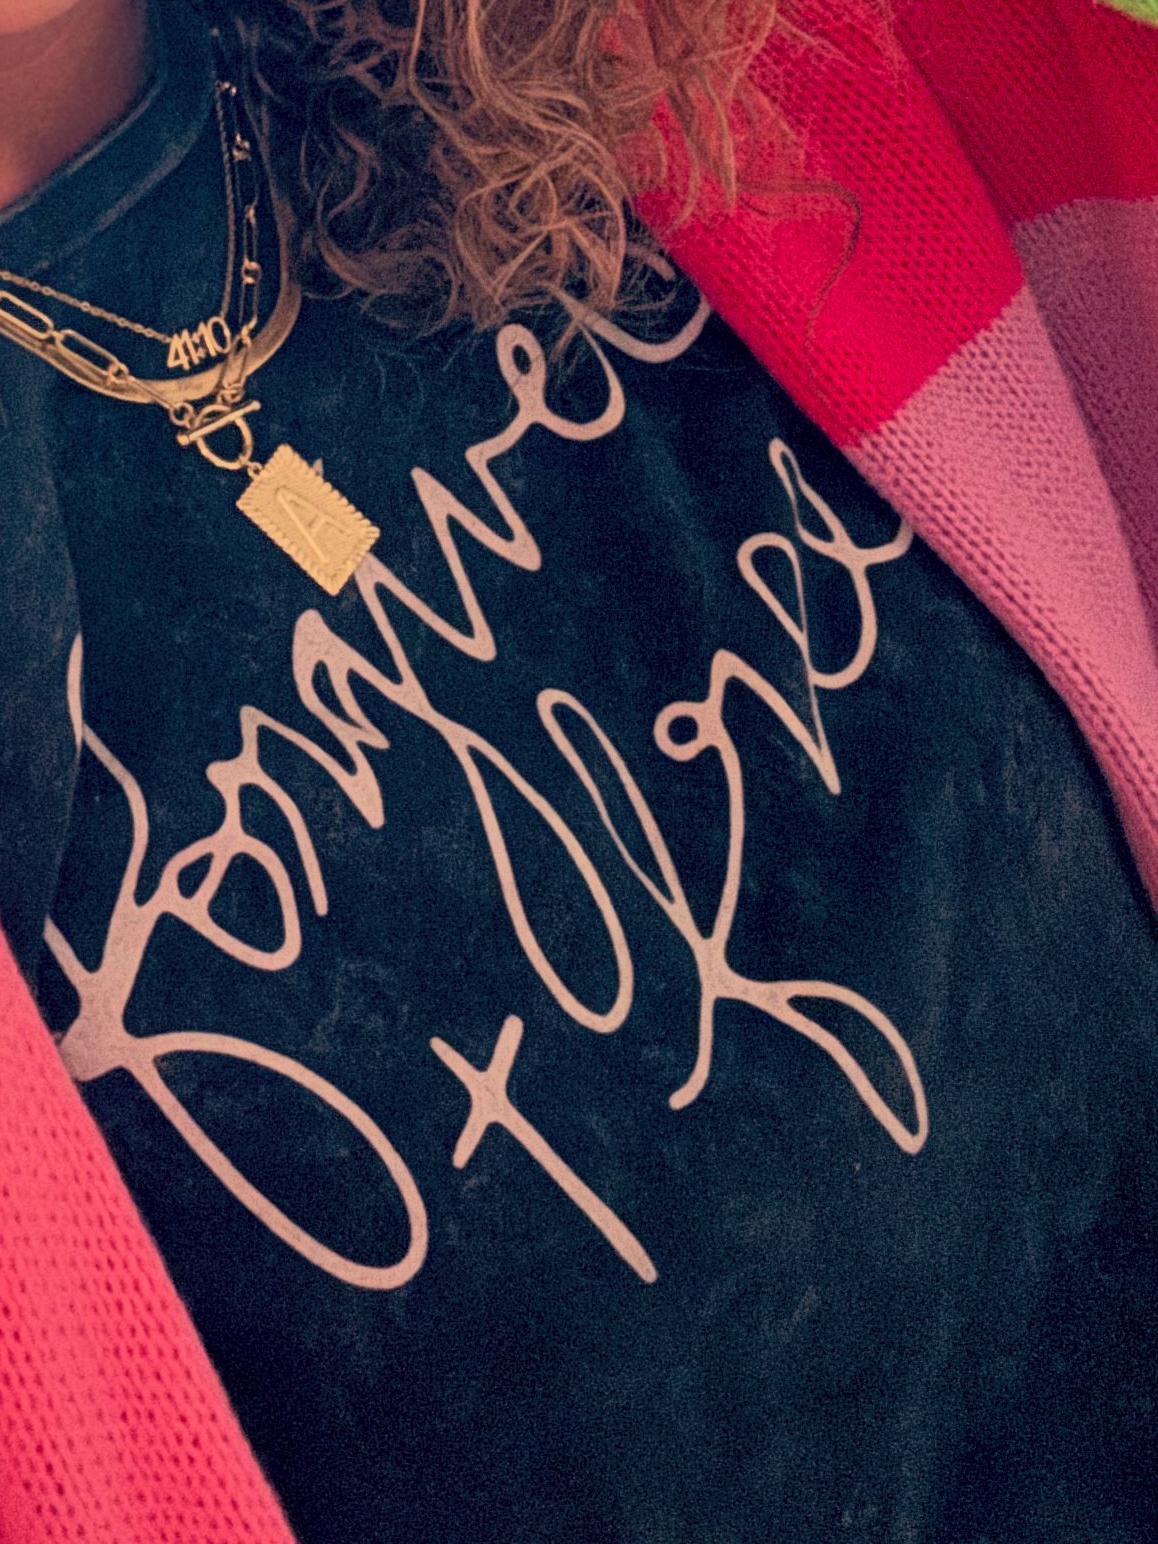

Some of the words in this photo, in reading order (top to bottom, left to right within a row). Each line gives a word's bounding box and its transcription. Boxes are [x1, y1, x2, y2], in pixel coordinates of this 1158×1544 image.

[166, 316, 232, 371] 41:10
[275, 485, 352, 564] A
[535, 436, 930, 1155] free
